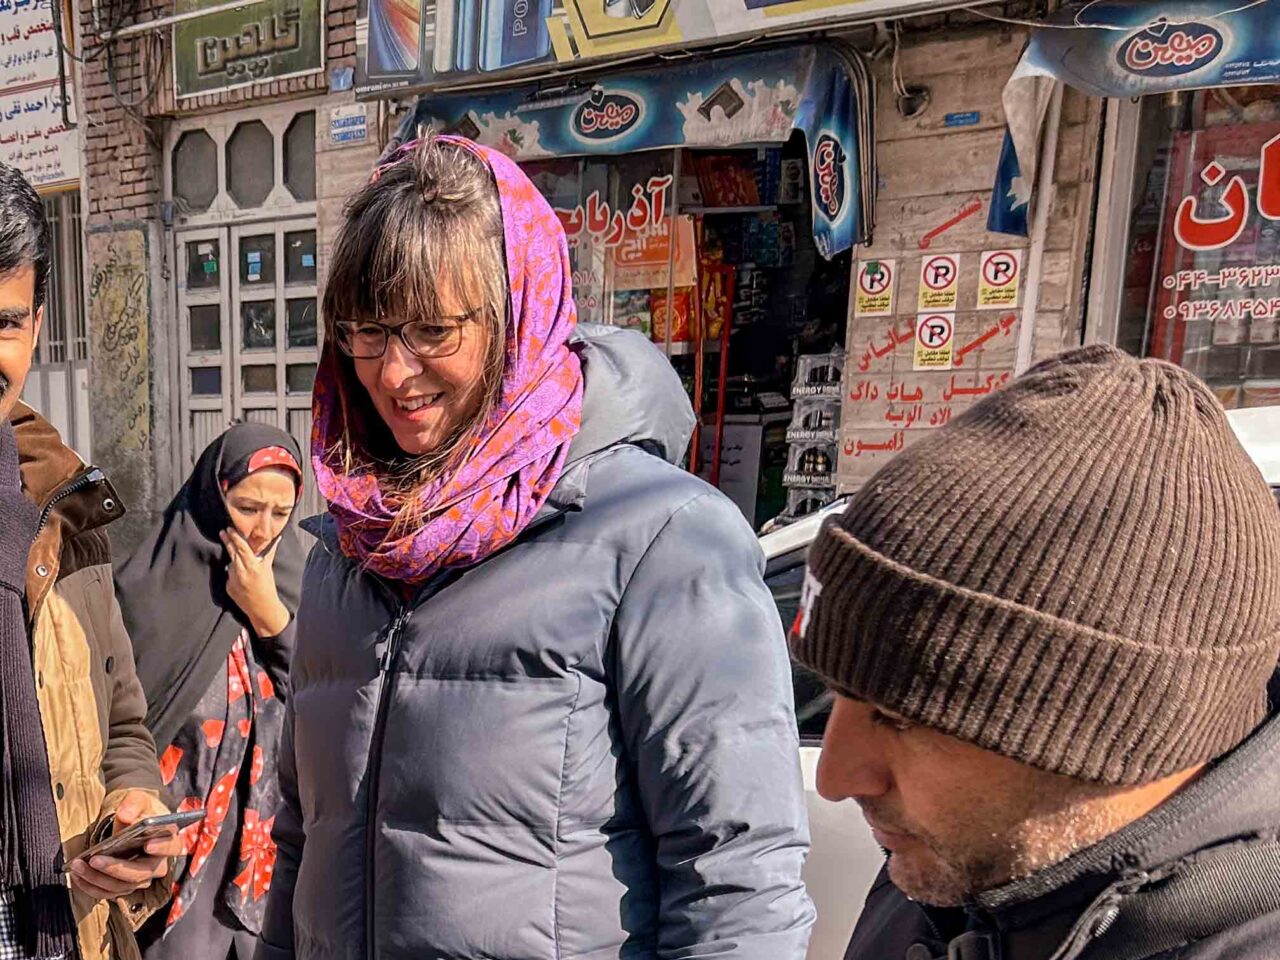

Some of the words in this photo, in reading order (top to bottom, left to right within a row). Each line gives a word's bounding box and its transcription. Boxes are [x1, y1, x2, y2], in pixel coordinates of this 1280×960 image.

[1126, 31, 1216, 69] میهن
[580, 102, 635, 133] میهن
[792, 386, 821, 395] ENERGY
[929, 406, 953, 426] الاد
[786, 431, 815, 439] ENERGY
[783, 475, 811, 483] ENERGY
